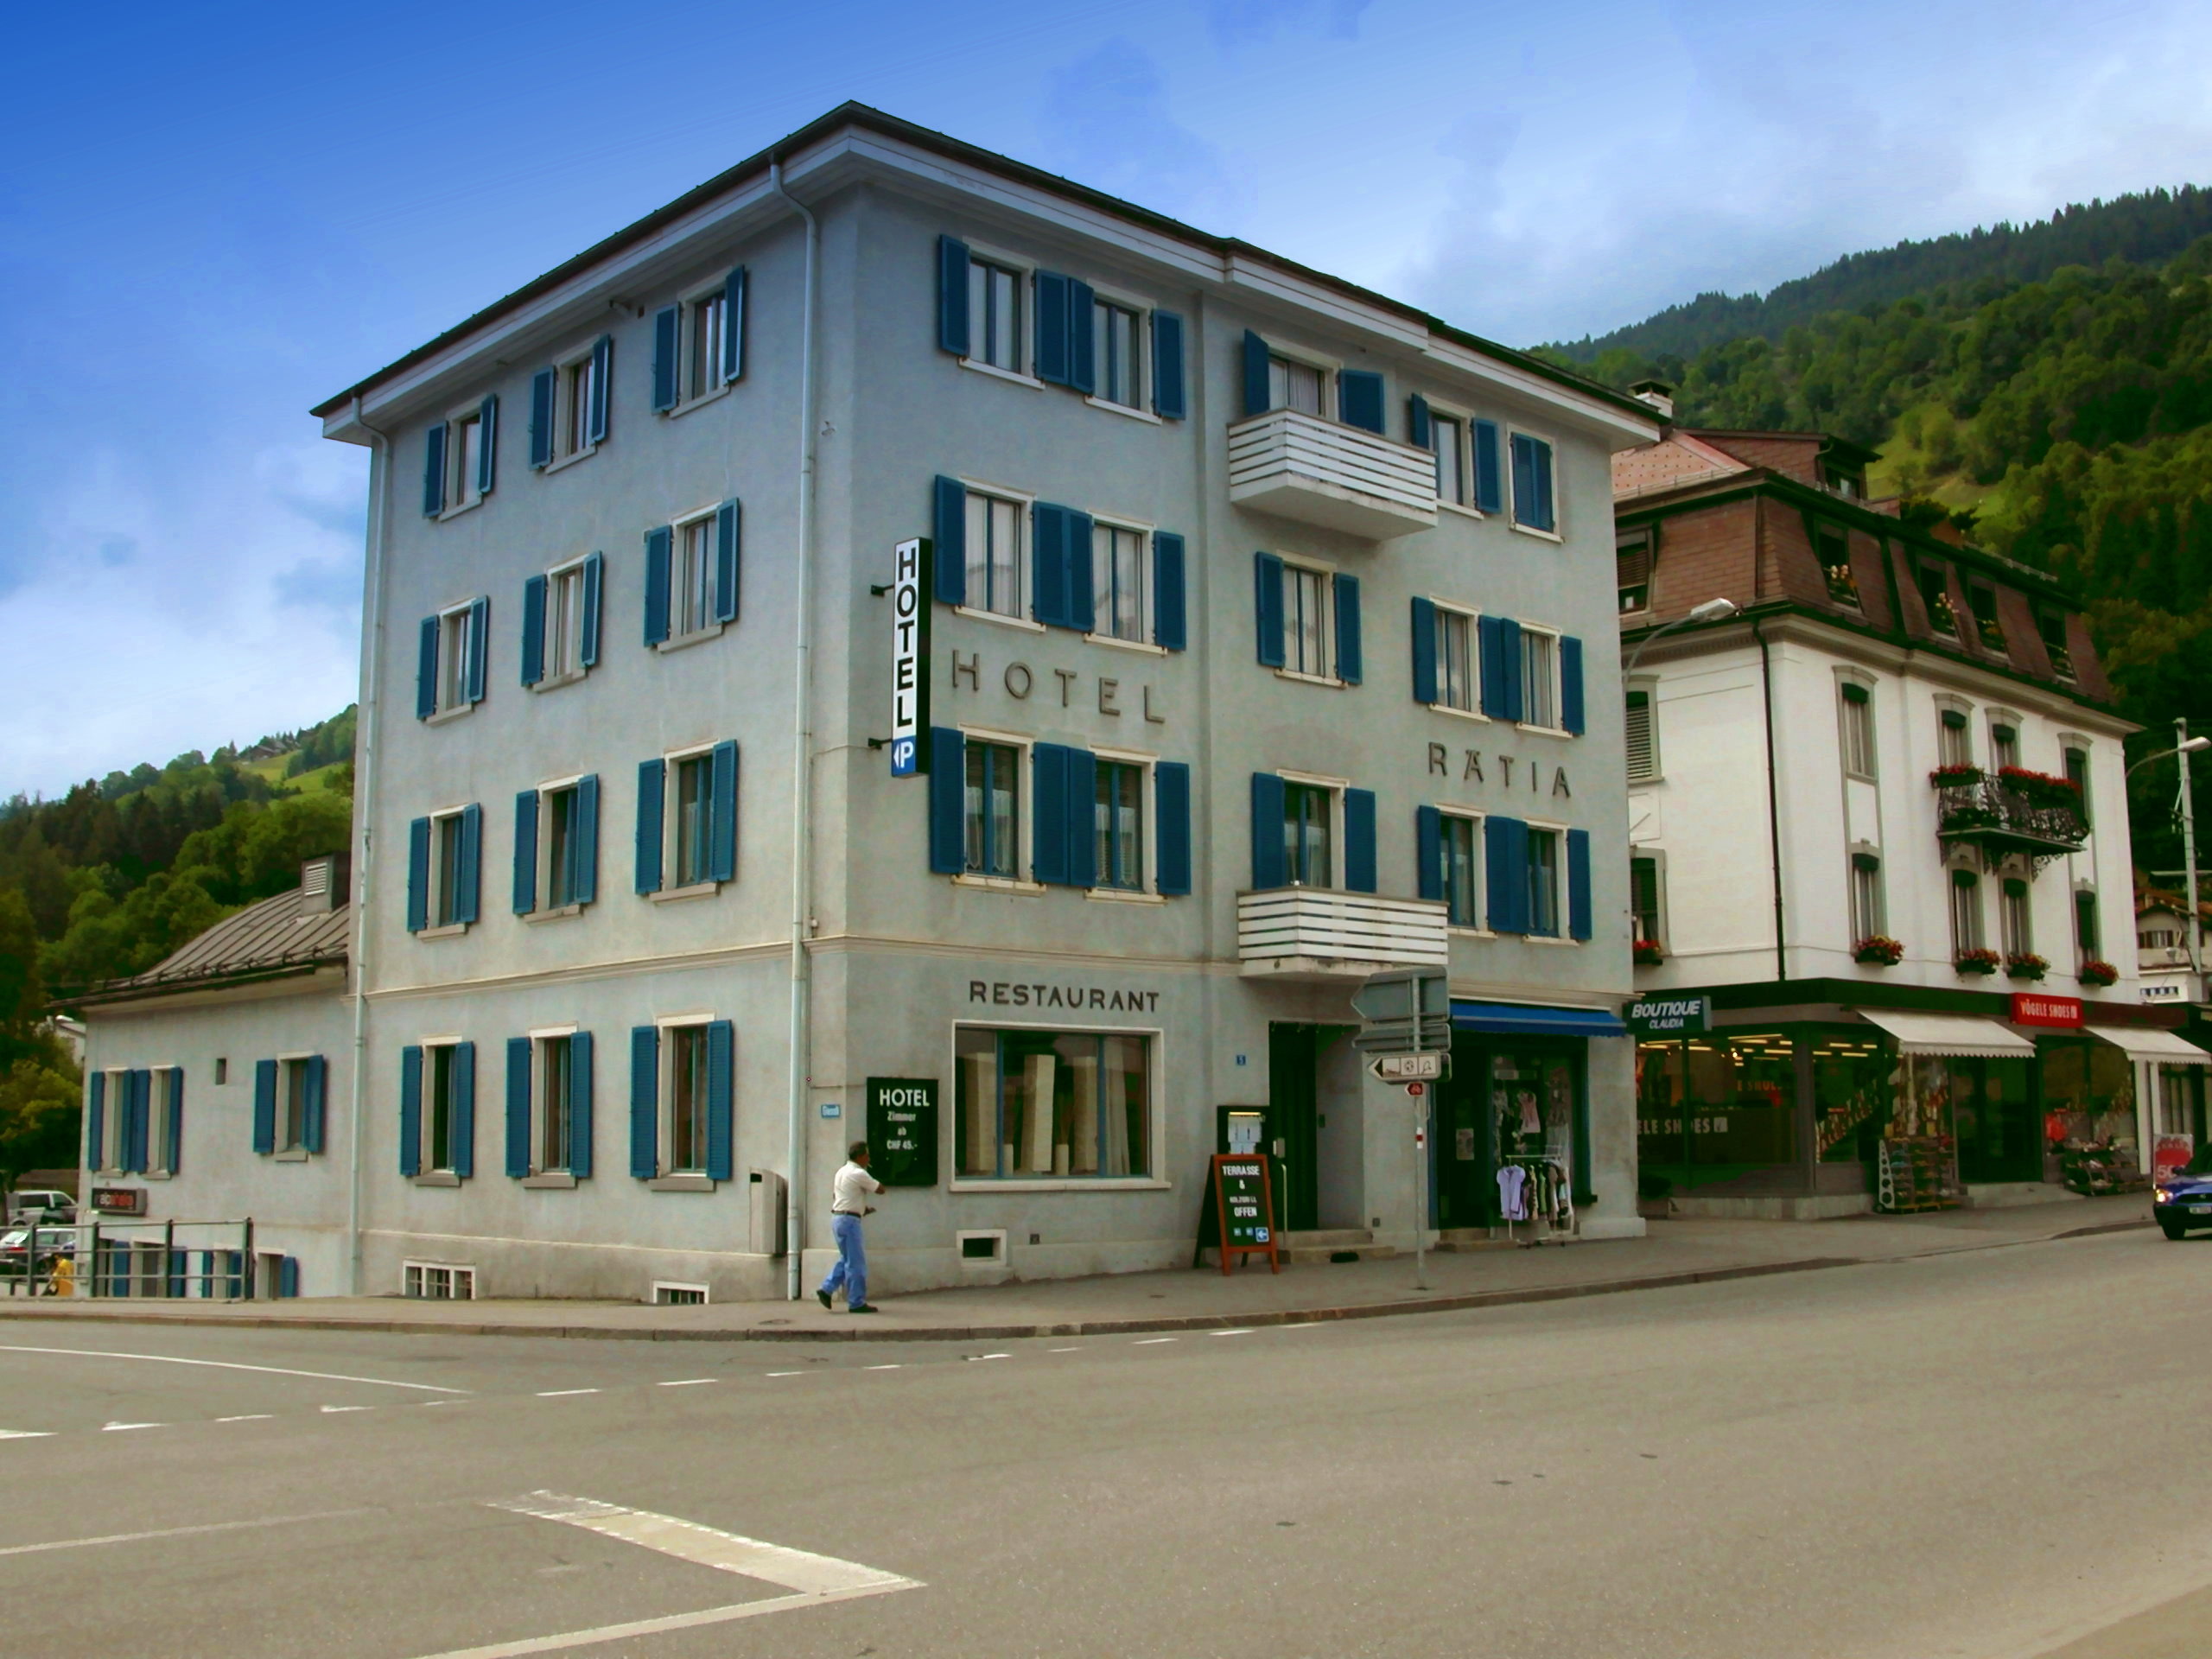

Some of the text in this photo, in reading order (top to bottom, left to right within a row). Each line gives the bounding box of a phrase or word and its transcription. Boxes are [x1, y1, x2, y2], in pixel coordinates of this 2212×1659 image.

[896, 547, 917, 728] HOTEL
[952, 649, 1165, 724] HOTEL
[1428, 741, 1571, 798] RÄTIA
[969, 981, 1160, 1013] RESTAURANT
[1631, 1000, 1701, 1019] BOUTIQUE
[2049, 1004, 2069, 1019] SHOES
[1649, 1018, 1684, 1029] CLAUDIA
[880, 1089, 930, 1107] HOTEL
[887, 1111, 916, 1122] Zimmer
[887, 1140, 901, 1150] CHF
[1222, 1165, 1260, 1176] TERRASSE
[1234, 1206, 1257, 1217] OFFEN
